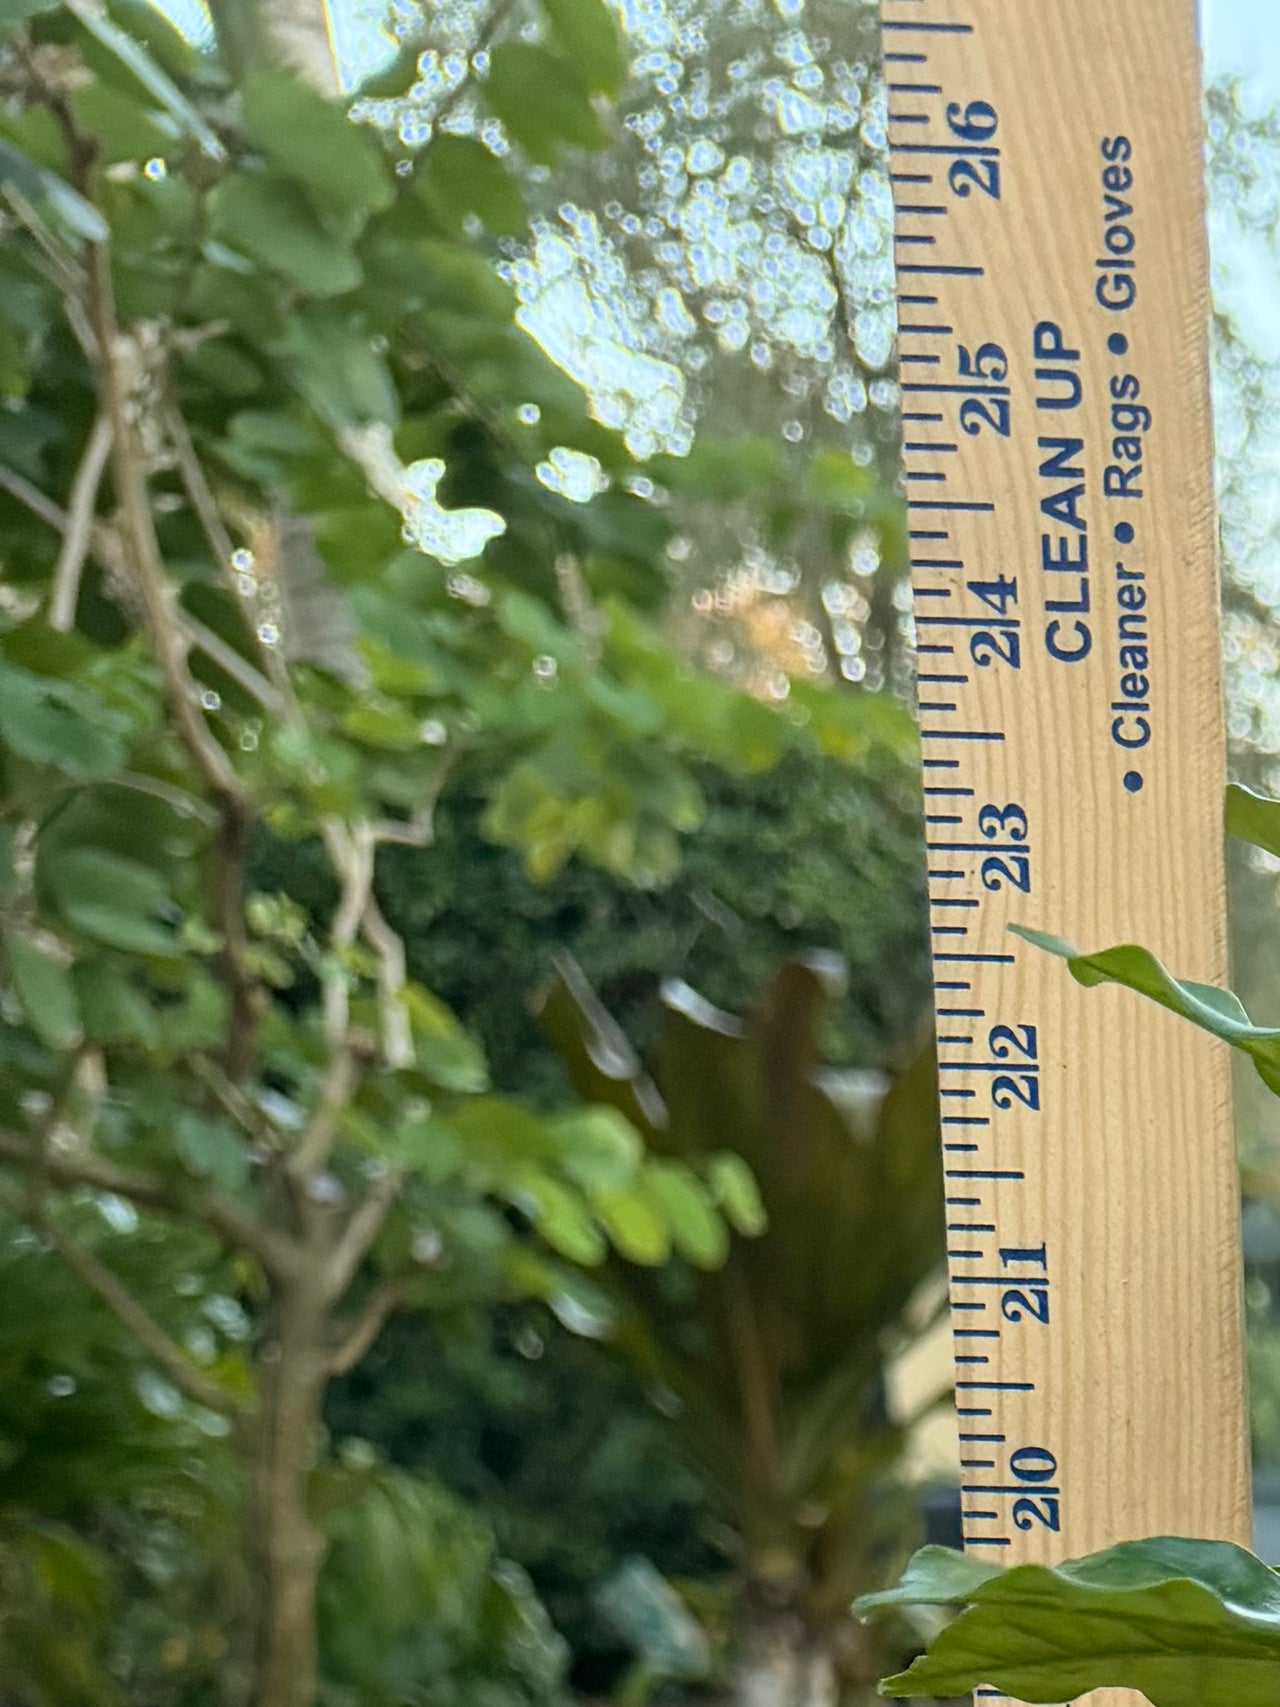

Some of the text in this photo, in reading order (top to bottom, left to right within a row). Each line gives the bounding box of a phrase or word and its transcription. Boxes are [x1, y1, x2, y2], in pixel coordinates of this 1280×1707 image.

[945, 100, 1000, 200] 26
[957, 342, 1011, 437] 25
[1095, 135, 1151, 749] Cleaner Rags Gloves
[1033, 321, 1092, 663] CLEAN UP
[967, 574, 1021, 669] 24
[978, 803, 1031, 893] 23
[988, 1023, 1041, 1111] 22
[999, 1242, 1050, 1325] 21
[1009, 1446, 1061, 1532] 20
